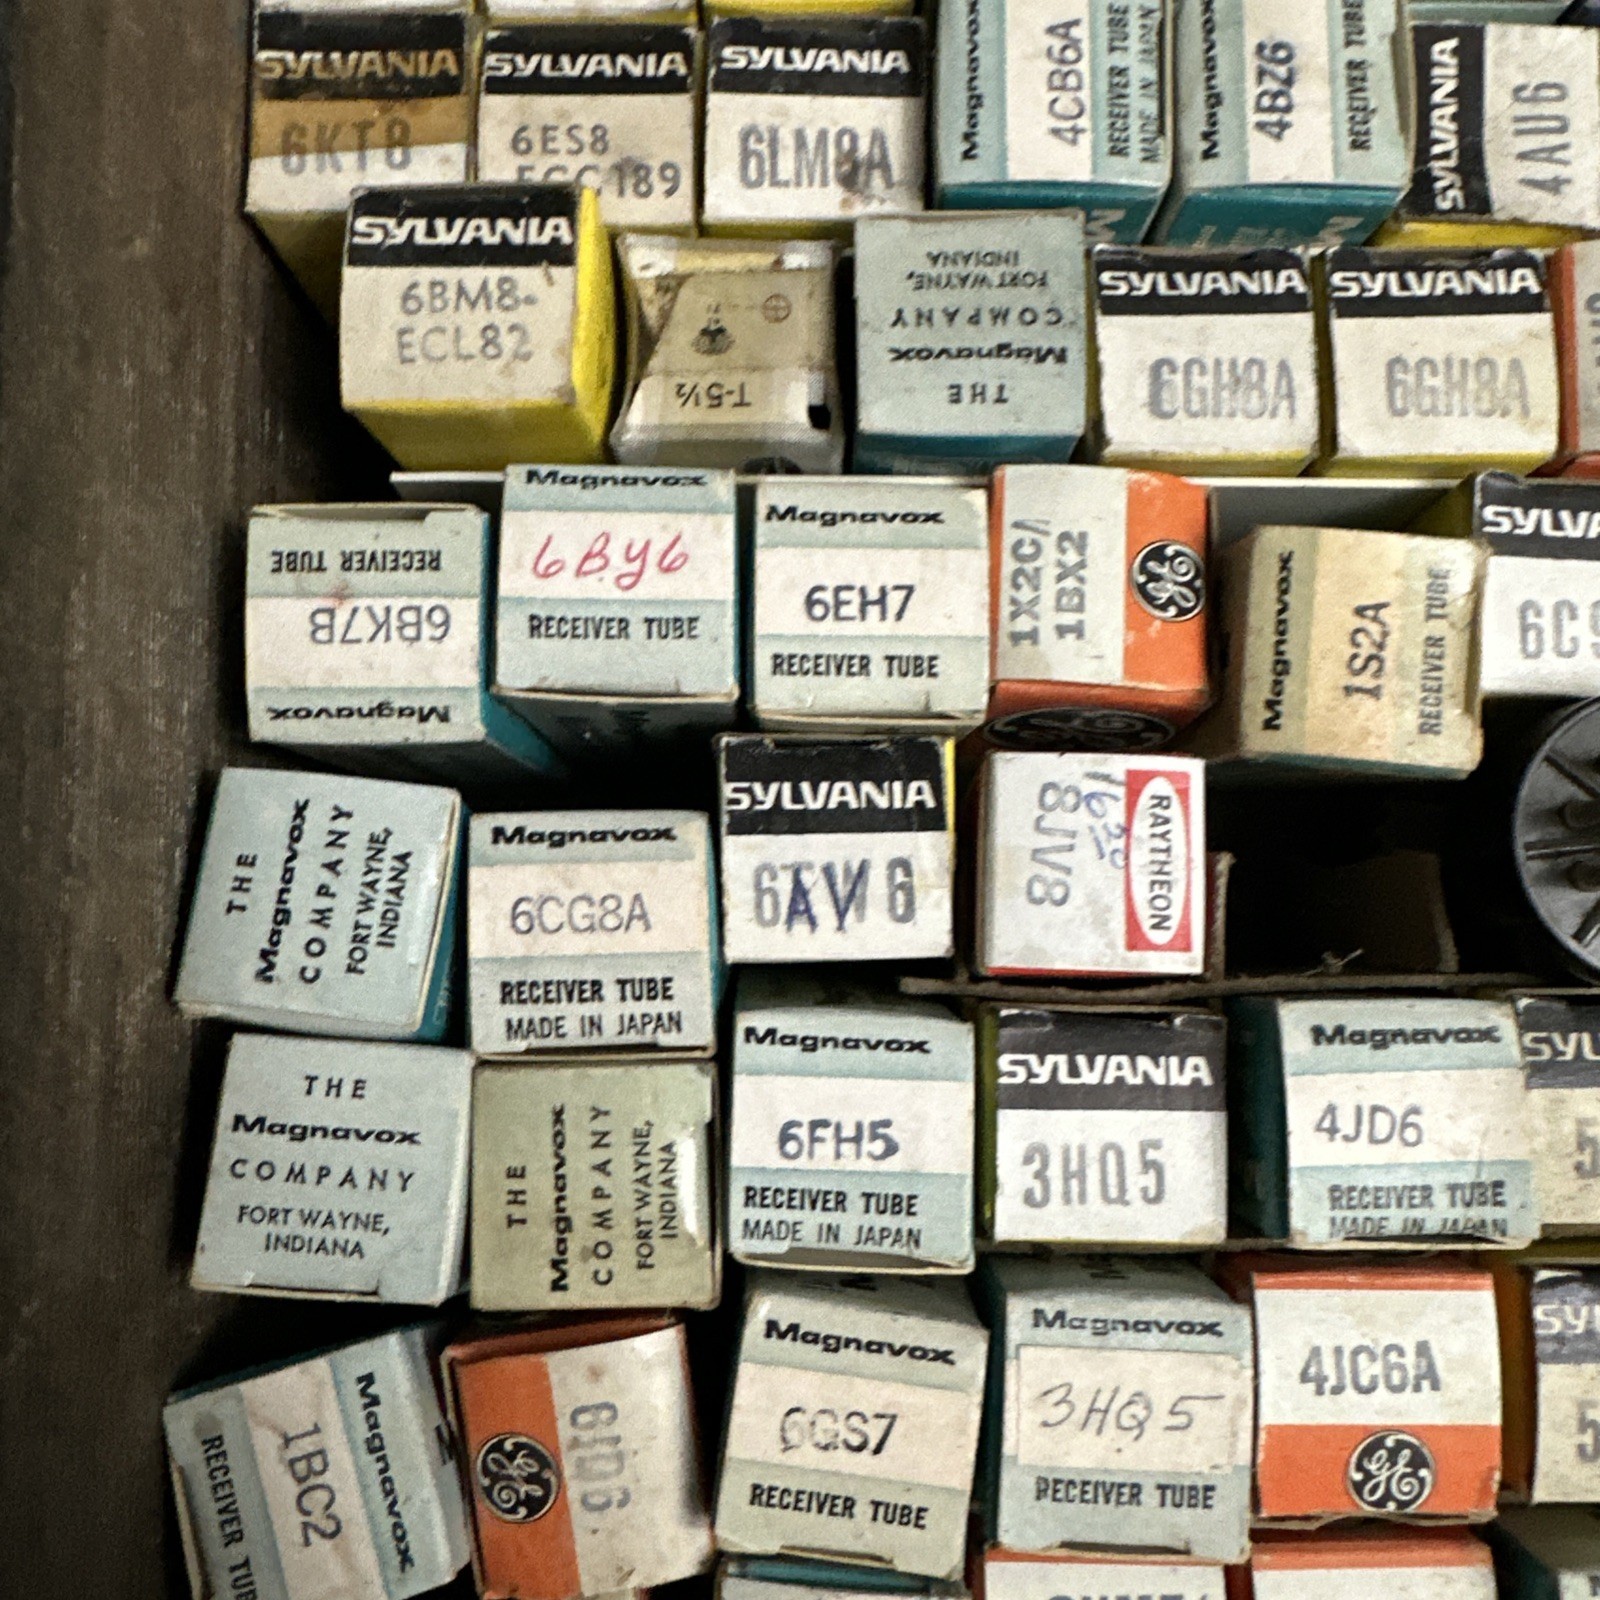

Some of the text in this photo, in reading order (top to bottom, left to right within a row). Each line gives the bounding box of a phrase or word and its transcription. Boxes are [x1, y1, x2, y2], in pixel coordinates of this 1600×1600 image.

[256, 49, 460, 79] SYLVANIA
[486, 53, 688, 78] SYLVANIA
[721, 45, 909, 74] SYLVANIA
[1107, 2, 1130, 156] RECEIVER TUBE
[1044, 18, 1087, 146] 4CB6A
[1254, 39, 1296, 143] 4BZ6
[1344, 60, 1374, 152] RECEIVER
[1428, 37, 1465, 212] SYLVANIA
[281, 118, 412, 175] 6KT8
[511, 124, 609, 155] 6ES8
[738, 124, 895, 190] 6LM8A
[1511, 81, 1572, 196] 4AU6
[352, 216, 573, 247] SYLVANIA
[926, 250, 1019, 267] INDIANA
[996, 271, 1049, 288] FORT
[1100, 268, 1308, 297] SYLVANIA
[1330, 267, 1542, 298] SYLVANIA
[892, 308, 1063, 327] COMPANY
[398, 323, 533, 364] ECL82
[888, 343, 1068, 364] Magnavox
[947, 383, 1009, 404] THE
[1147, 356, 1297, 420] 6GH8A
[524, 469, 706, 490] Magnavox
[765, 505, 945, 526] Magnavox
[271, 550, 442, 573] RECEIVER TUBE
[804, 584, 916, 622] 6EH7
[1010, 519, 1052, 647] 1X2C/
[1055, 530, 1089, 641] 1BX2
[309, 604, 451, 645] 6BK7B
[528, 614, 700, 640] RECEIVER TUBE
[1262, 550, 1294, 731] Magnavox
[771, 653, 940, 679] RECEIVER TUBE
[1342, 601, 1391, 700] 1S2A
[1418, 566, 1451, 735] RECEIVER TUBE
[266, 704, 450, 724] Magnavox
[726, 780, 936, 811] SYLVANIA
[491, 825, 676, 846] Magnavox
[1027, 780, 1082, 907] 8JV8
[1148, 794, 1173, 932] RAYTHEON
[226, 853, 257, 915] THE
[255, 799, 309, 983] Magnavox
[300, 805, 354, 984] COMPANY
[347, 827, 394, 975] FORT WAYNE,
[376, 850, 414, 948] INDIANA
[510, 895, 652, 936] 6CG8A
[500, 977, 674, 1005] RECEIVER TUBE
[505, 1011, 681, 1041] MADE IN JAPAN
[744, 1026, 931, 1054] Magnavox
[1311, 1024, 1501, 1050] Magnavox
[304, 1075, 368, 1099] THE
[997, 1053, 1214, 1086] SYLVANIA
[231, 1113, 421, 1145] Magnavox
[778, 1118, 899, 1161] 6FH5
[1314, 1101, 1424, 1148] 4JD6
[230, 1158, 417, 1193] COMPANY
[659, 1140, 678, 1239] INDIANA
[1022, 1138, 1167, 1208] 3HQ5
[506, 1164, 526, 1230] THE
[550, 1104, 568, 1293] Magnavox
[590, 1105, 613, 1286] COMPANY
[633, 1121, 655, 1270] FORT WAYNE,
[743, 1185, 918, 1216] RECEIVER TUBE
[1329, 1180, 1506, 1210] RECEIVER TUBE
[237, 1204, 390, 1236] FORT WAYNE,
[741, 1217, 922, 1250] MADE IN JAPAN
[1330, 1217, 1389, 1238] MADE
[1402, 1217, 1425, 1234] IN
[264, 1233, 365, 1260] INDIANA
[764, 1319, 956, 1366] Magnavox
[1032, 1308, 1224, 1337] Magnavox
[1300, 1339, 1441, 1396] 4JC6A
[201, 1434, 244, 1548] RECEIVER
[283, 1421, 343, 1548] 1BC2
[355, 1372, 417, 1574] Magnavox
[1035, 1476, 1216, 1509] RECEIVER TUBE
[749, 1483, 929, 1530] RECEIVER TUBE
